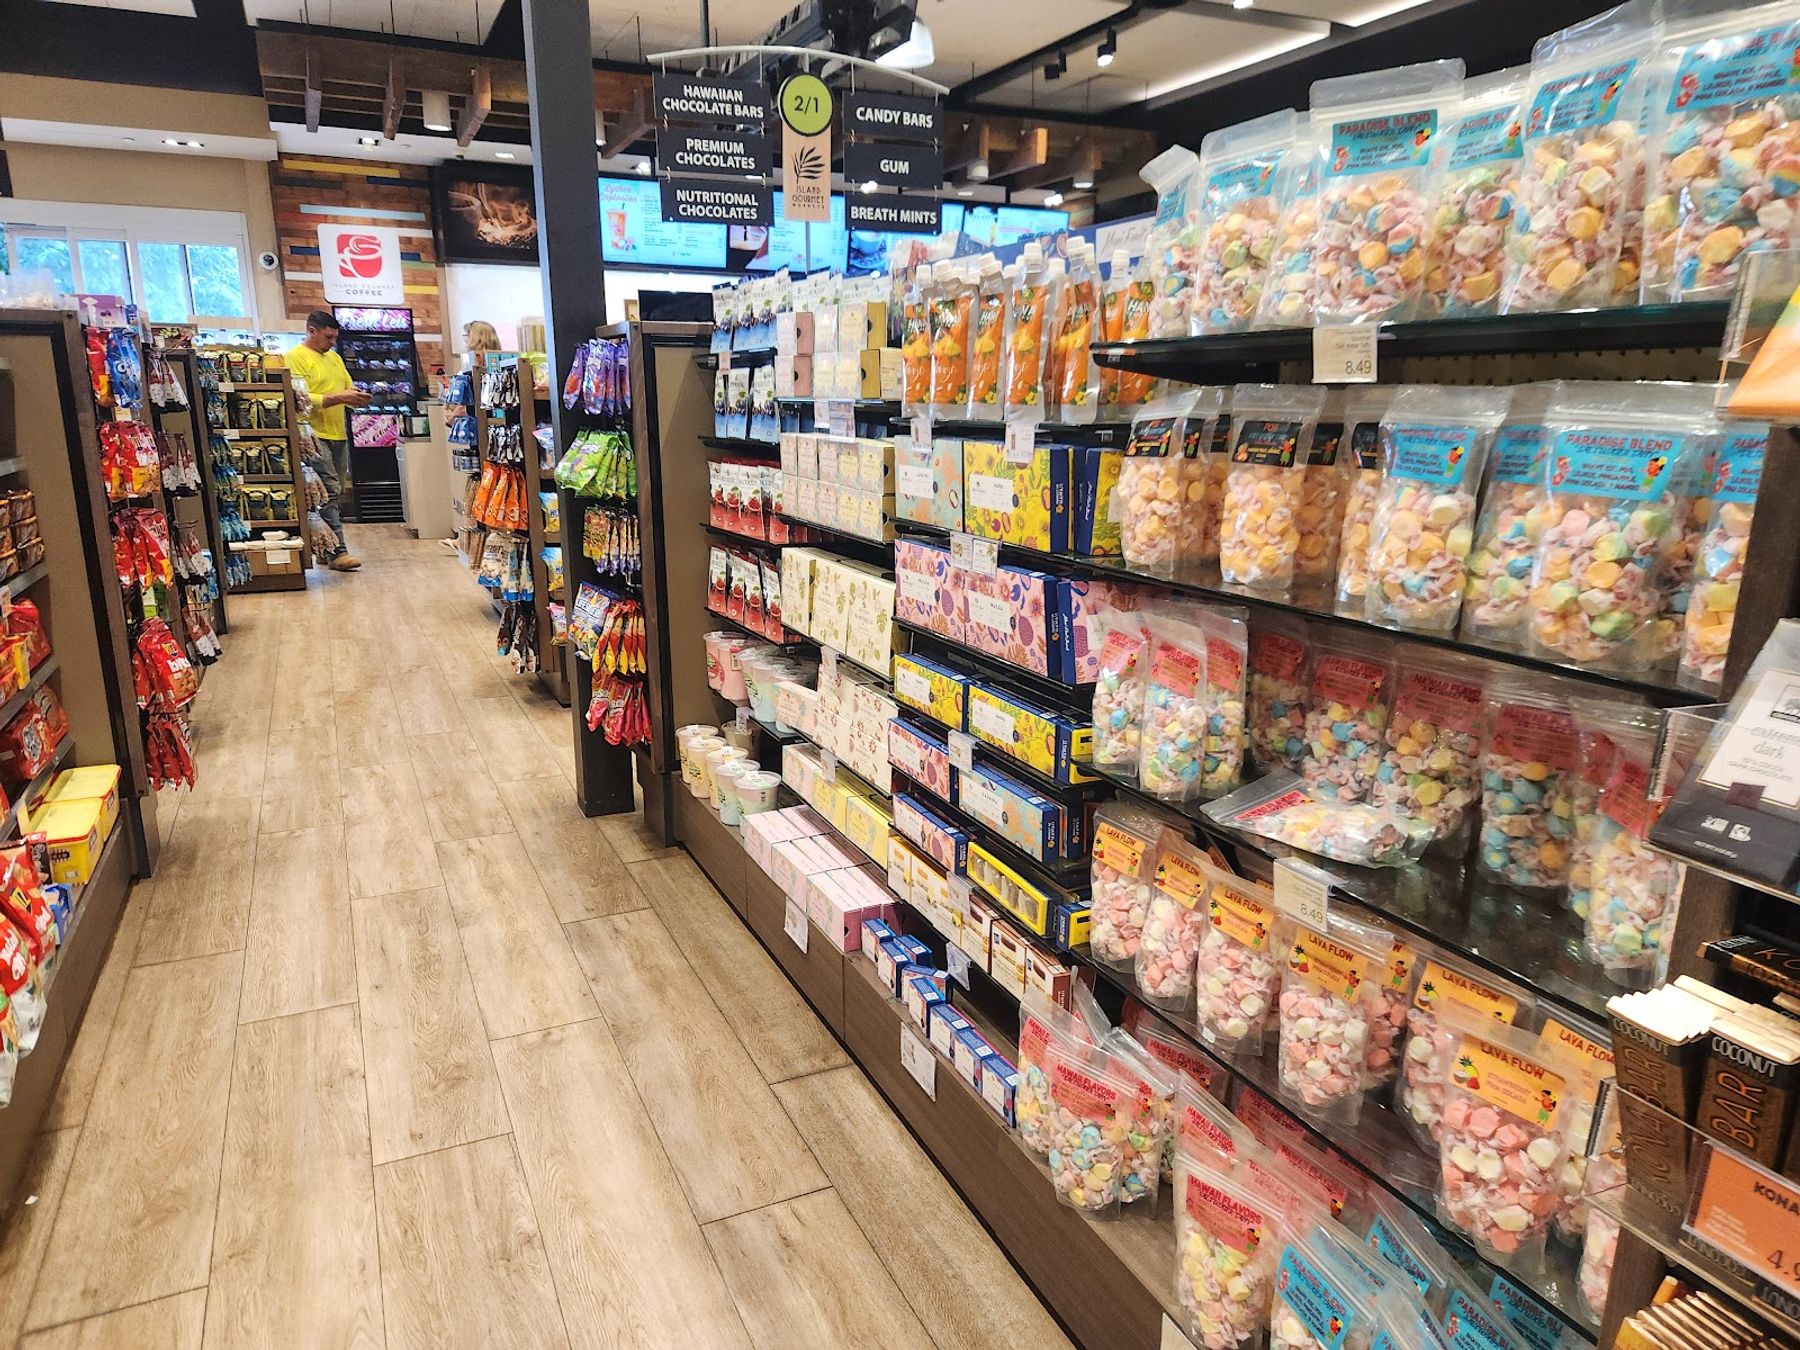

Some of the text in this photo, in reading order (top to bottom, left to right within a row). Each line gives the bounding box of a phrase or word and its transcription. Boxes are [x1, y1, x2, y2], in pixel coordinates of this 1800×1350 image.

[683, 84, 743, 102] HAWAIIAN
[663, 98, 764, 119] CHOCOLATE BARS
[794, 95, 820, 115] 2/1
[856, 107, 933, 129] CANDY BARS
[1338, 113, 1430, 135] PARADISE BLEND
[686, 138, 745, 155] PREMIUM
[675, 152, 756, 170] CHOCOLATES
[880, 159, 910, 175] GUM
[676, 189, 759, 207] NUTRITIONAL
[792, 195, 824, 204] GOURMET
[796, 185, 821, 194] ISLAND
[678, 204, 758, 220] CHOCOLATES
[850, 205, 937, 225] BREATH MINTS
[1345, 360, 1372, 375] 8.49
[1263, 422, 1280, 432] POG
[1565, 434, 1673, 452] PARADISE BLEND
[1753, 741, 1785, 759] dark
[1106, 827, 1137, 847] LAVA FLOW
[1171, 855, 1200, 877] LAVA FLOW
[1225, 889, 1264, 916] LAVA FLOW
[1300, 903, 1324, 924] 8.49
[1309, 933, 1354, 962] LAVA FLOW
[1442, 969, 1501, 1002] LAVA FLOW
[1560, 1029, 1583, 1051] LAVA
[1613, 1017, 1670, 1056] COCONUT
[1151, 1041, 1177, 1058] HAWAII
[1711, 1036, 1779, 1078] COCONUT
[1481, 1041, 1545, 1080] LAVA FLOW
[1057, 1064, 1118, 1101] HAWAII FLAVORS
[1187, 1105, 1210, 1128] HAWAII
[1711, 1070, 1765, 1150] BAR
[1190, 1175, 1263, 1225] HAWAII FLAVORS
[1766, 1249, 1800, 1281] 4.9
[1499, 1282, 1545, 1318] PARADISE
[1457, 1296, 1500, 1338] PARADISE
